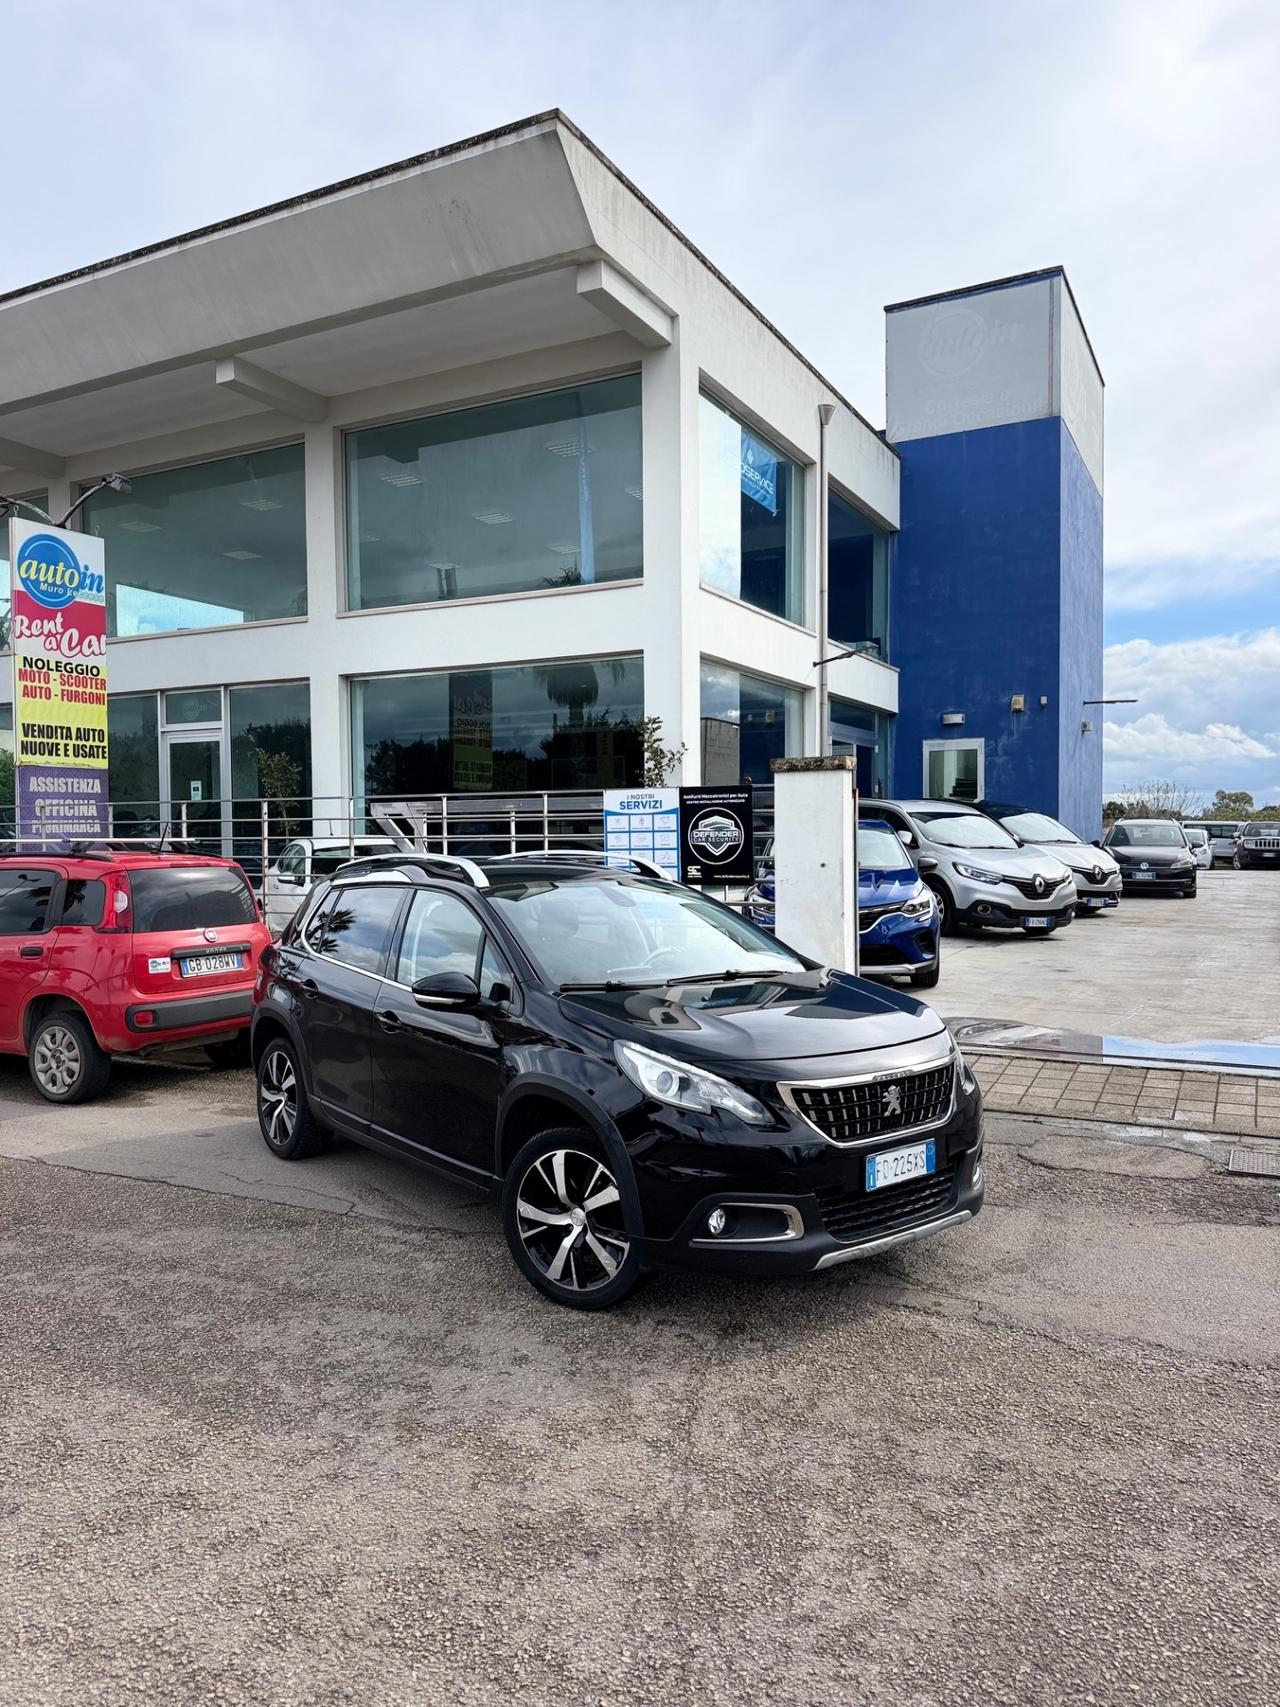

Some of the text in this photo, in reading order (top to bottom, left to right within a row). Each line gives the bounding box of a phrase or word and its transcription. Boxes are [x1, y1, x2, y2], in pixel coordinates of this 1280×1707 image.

[20, 559, 104, 593] autoin
[40, 582, 64, 595] Muro
[14, 612, 64, 638] Rent
[22, 656, 100, 677] NOLEGGIO
[18, 668, 50, 684] MOTO
[60, 673, 106, 691] SCOOTER
[22, 685, 51, 700] AUTO
[61, 689, 105, 705] FURGONI
[22, 723, 104, 742] VENDITA AUTO
[21, 741, 107, 759] NUOVE E USATE
[29, 776, 101, 794] ASSISTENZA
[35, 798, 97, 817] OFFICINA
[620, 800, 662, 810] SERVIZI
[189, 953, 235, 971] GB 028WV
[893, 1151, 925, 1176] 225XS
